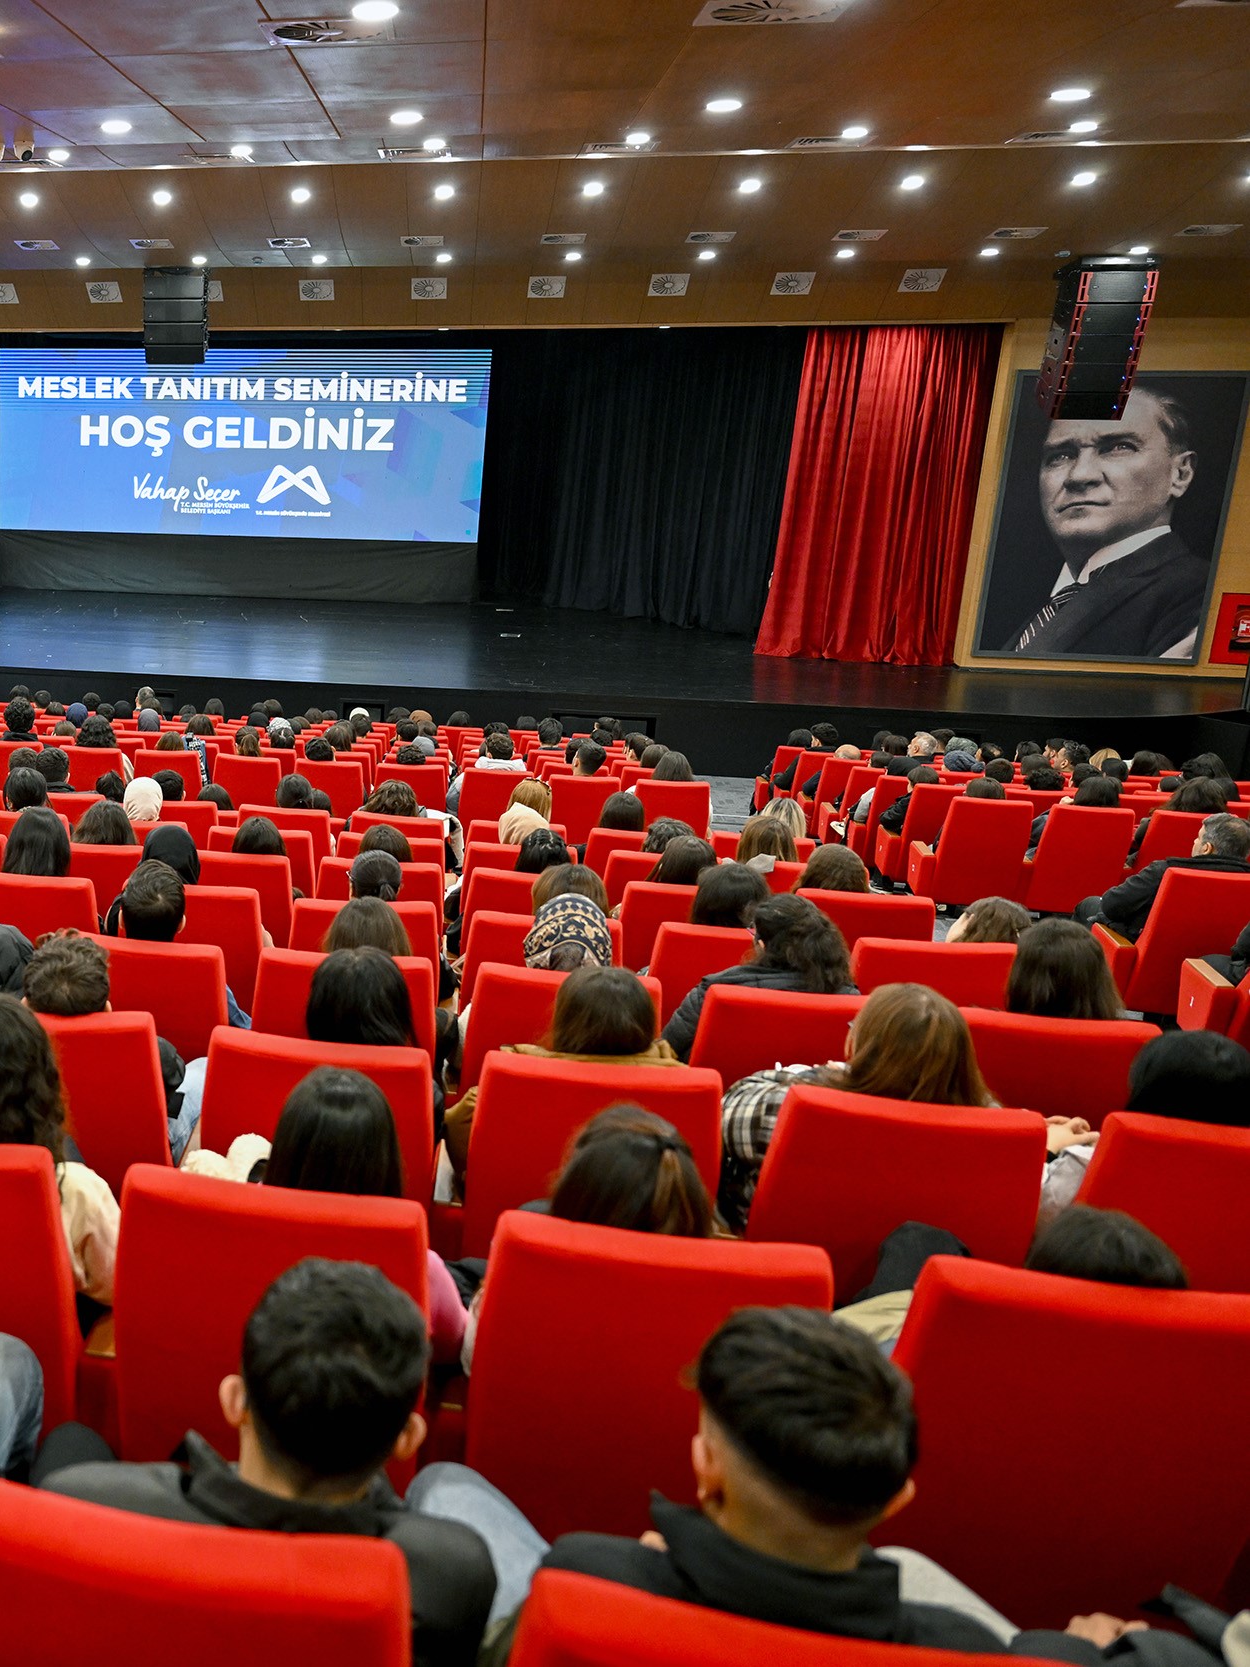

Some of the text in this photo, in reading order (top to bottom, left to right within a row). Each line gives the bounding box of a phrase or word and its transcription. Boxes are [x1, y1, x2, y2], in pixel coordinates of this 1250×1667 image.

[18, 371, 468, 402] MESLEK TANITIM SEMİNERİNE
[80, 407, 395, 457] HOŞ GELDİNİZ
[133, 472, 241, 512] Vahap Seçer
